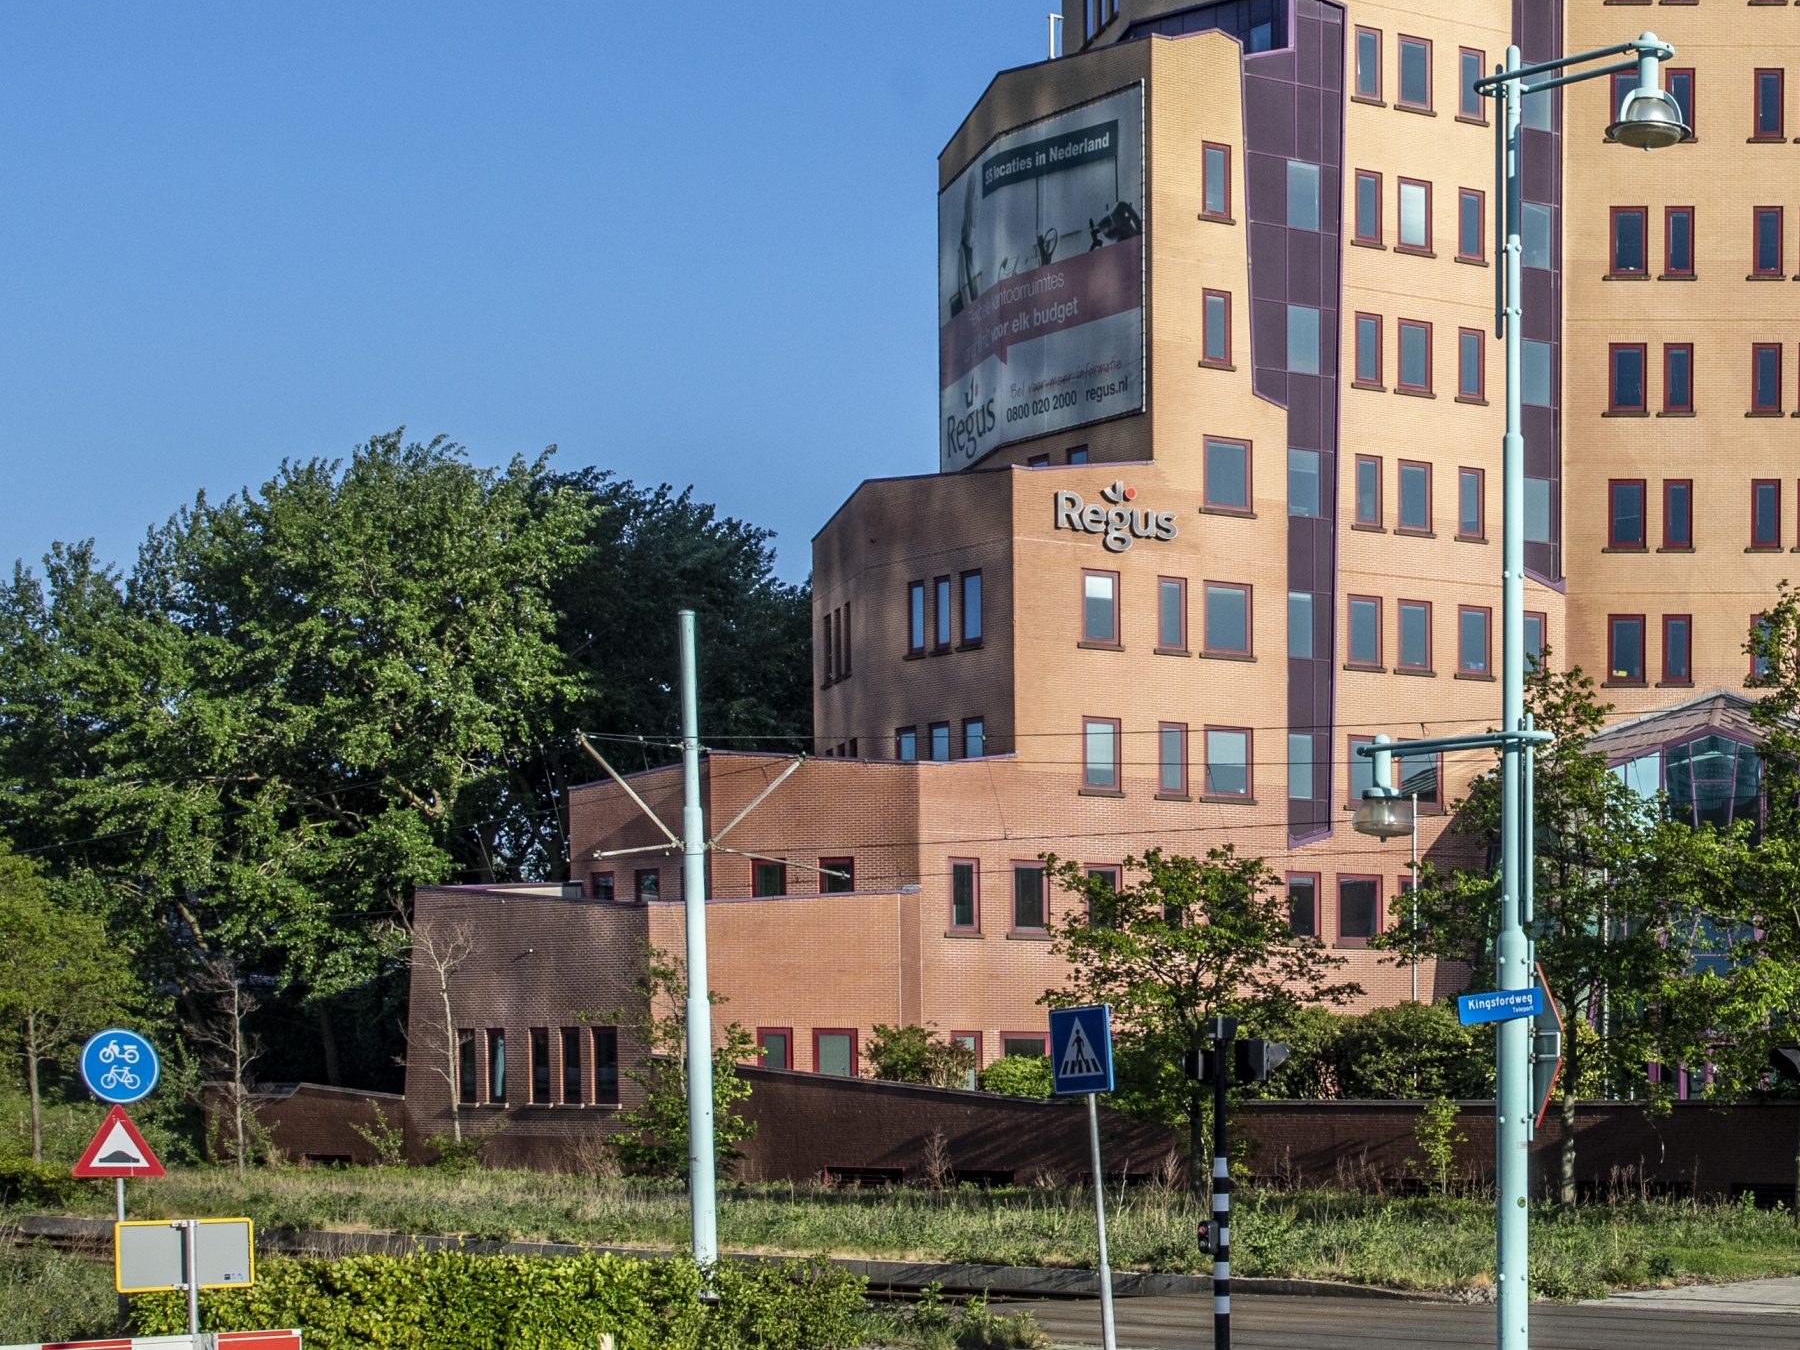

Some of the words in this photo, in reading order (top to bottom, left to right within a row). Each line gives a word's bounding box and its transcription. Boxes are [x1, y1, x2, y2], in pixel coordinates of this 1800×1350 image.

[985, 168, 993, 186] 55
[993, 157, 1033, 181] locaties
[1035, 151, 1047, 167] in
[1049, 132, 1110, 163] Nederland
[991, 320, 1009, 344] voor
[1012, 311, 1030, 334] elk
[1034, 297, 1079, 324] budget
[1006, 402, 1030, 423] 0800
[1032, 396, 1050, 417] 020
[1052, 389, 1077, 411] 2000
[1085, 375, 1128, 403] regus.nl
[1010, 380, 1025, 399] Bel
[1076, 354, 1123, 385] informatie
[947, 397, 997, 459] Regus
[1055, 490, 1178, 552] Regus
[1468, 994, 1533, 1011] Kingsfordweg
[1512, 1005, 1534, 1013] Teleport
